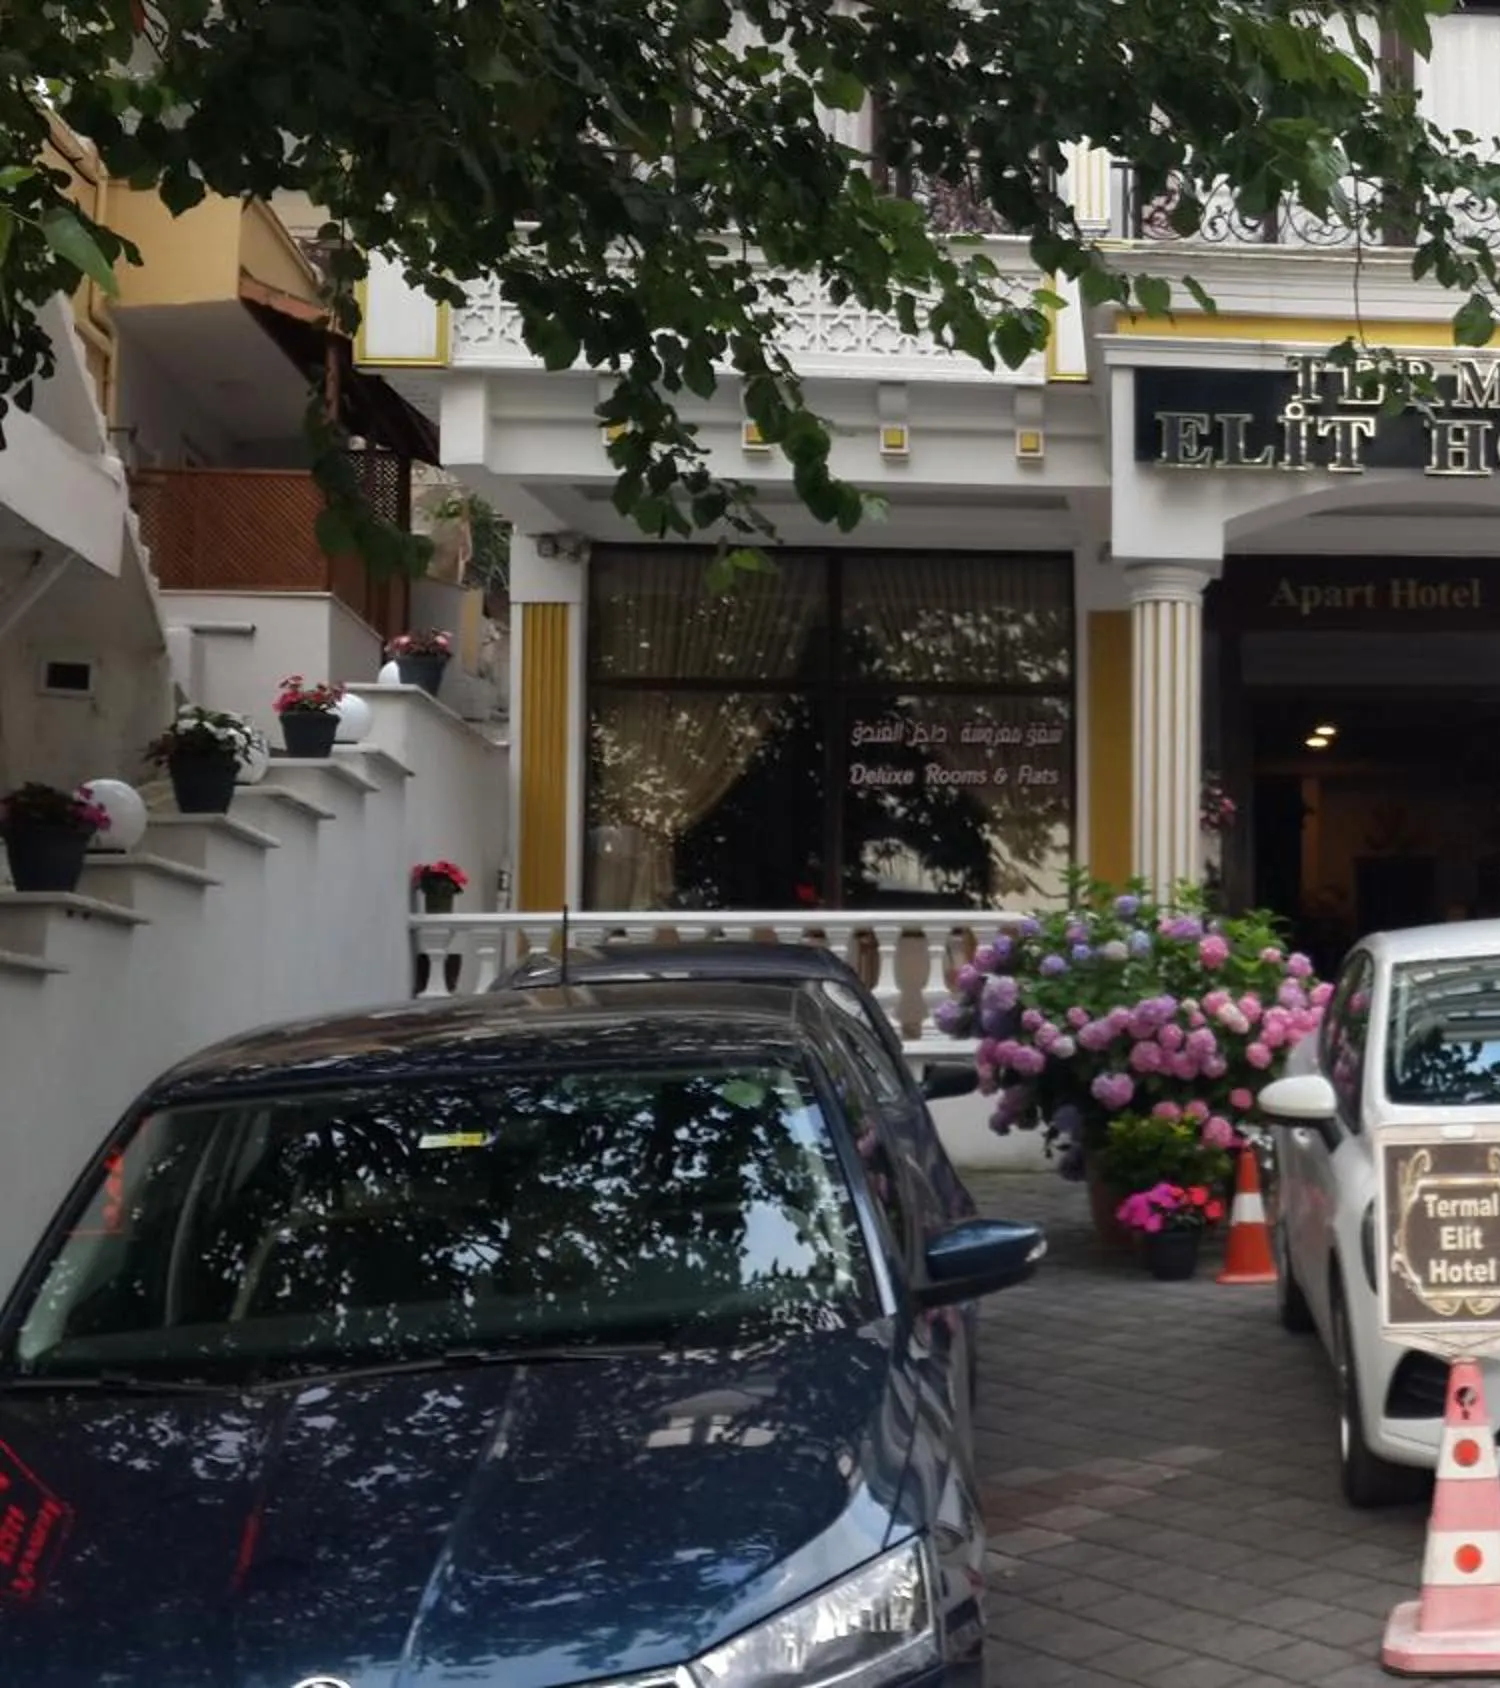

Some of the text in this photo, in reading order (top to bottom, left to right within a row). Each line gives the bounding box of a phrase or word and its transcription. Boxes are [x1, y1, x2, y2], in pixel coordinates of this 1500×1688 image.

[1269, 577, 1480, 615] Apart Hotel
[850, 763, 1059, 785] Deluxe Rooms & Flats
[1423, 1192, 1499, 1218] Termal
[1440, 1226, 1484, 1250] Elit
[1428, 1258, 1497, 1283] Hotel
